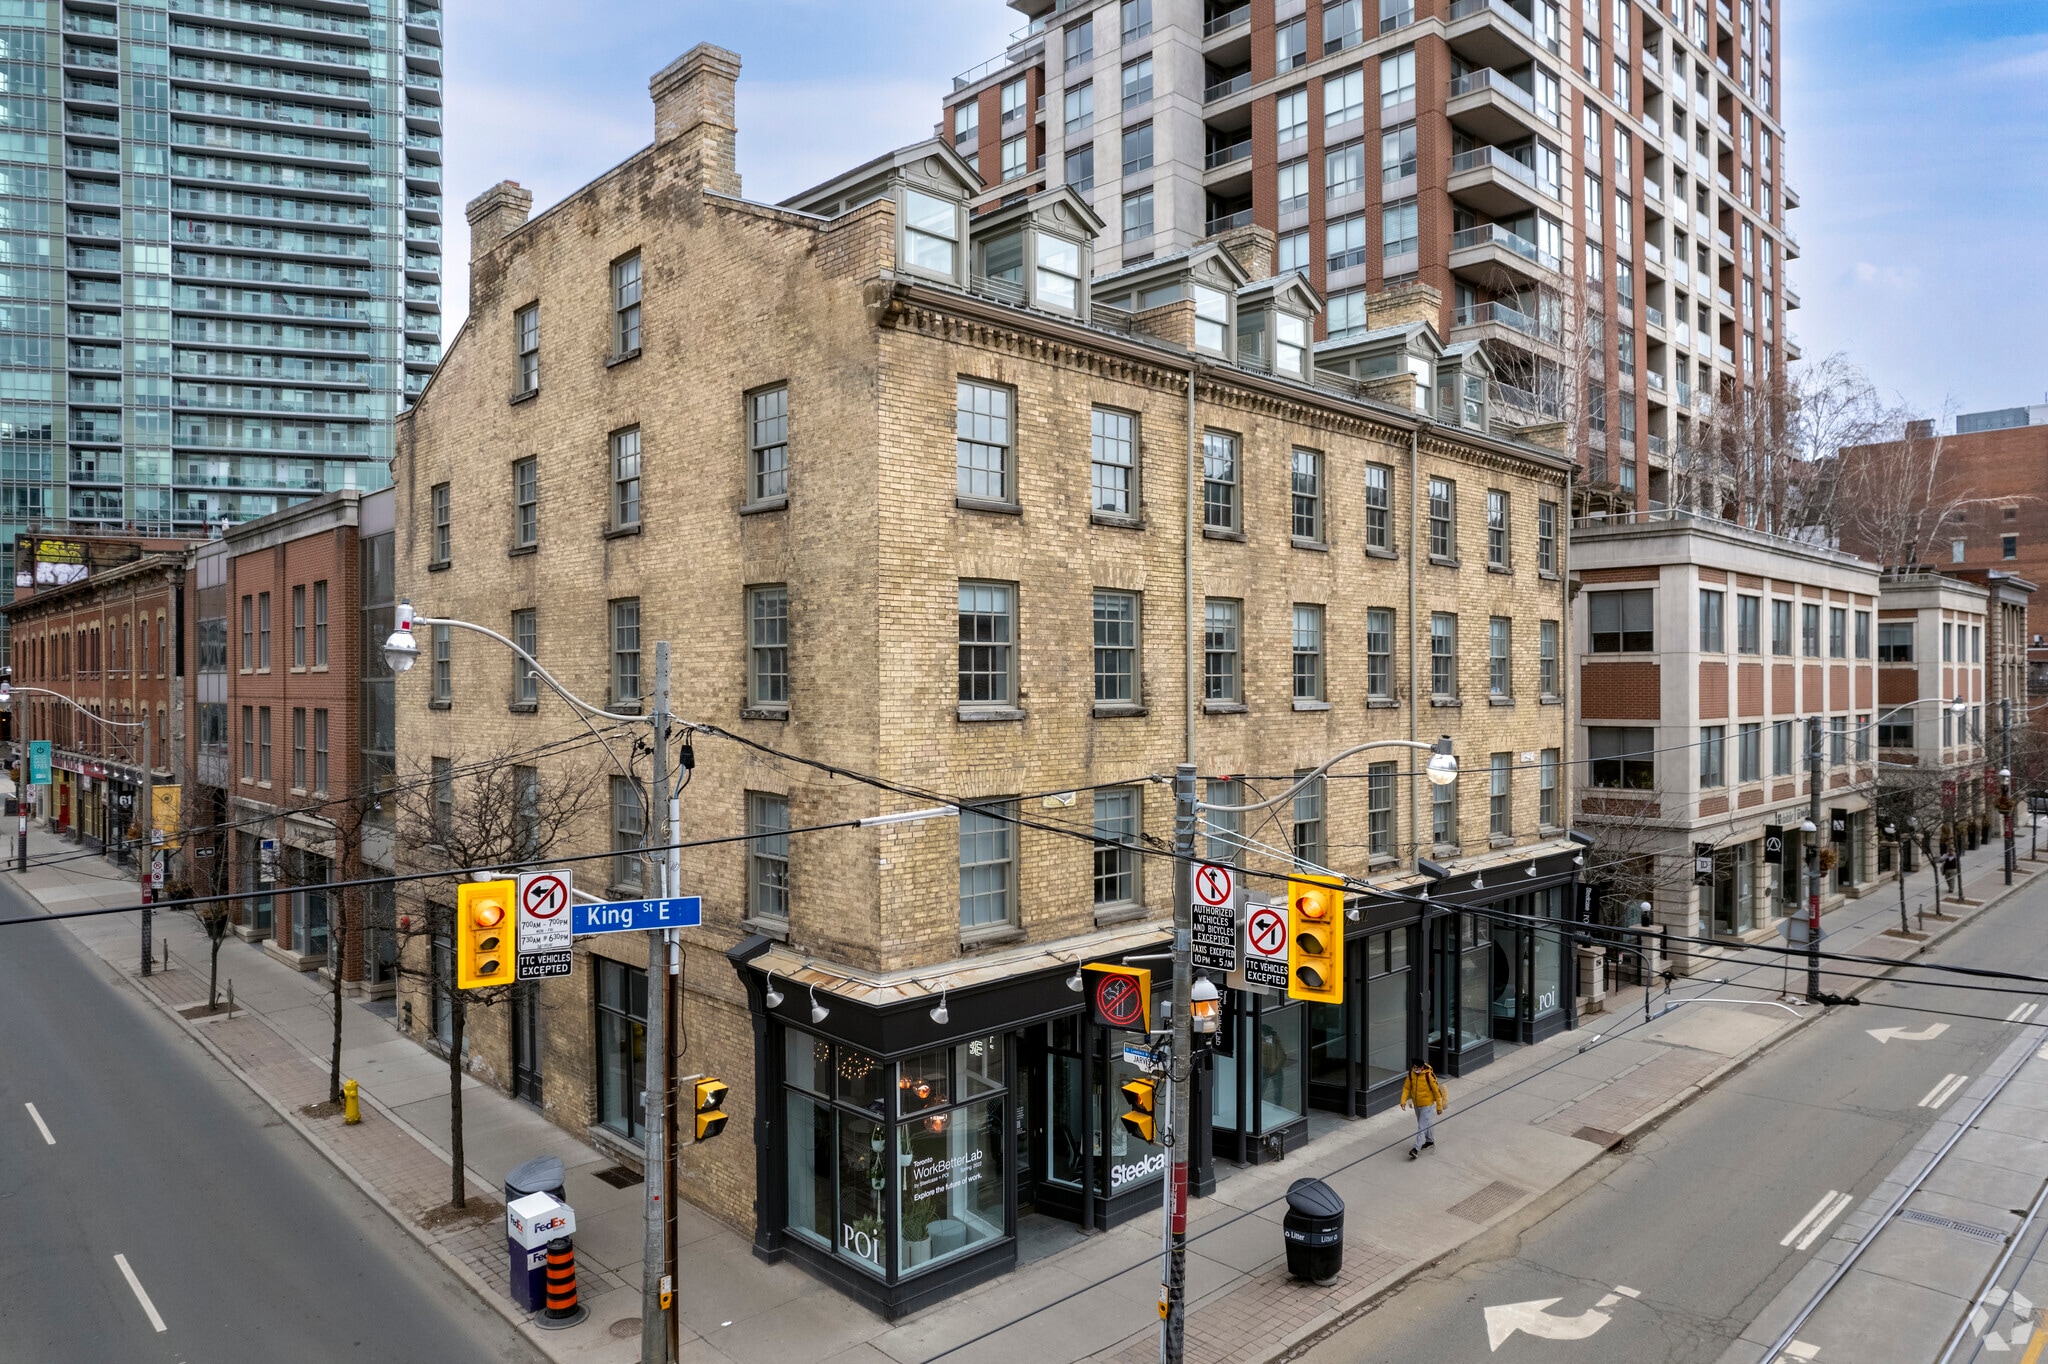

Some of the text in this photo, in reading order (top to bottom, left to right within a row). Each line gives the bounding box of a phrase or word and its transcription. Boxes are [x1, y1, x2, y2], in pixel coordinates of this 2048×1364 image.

[119, 795, 132, 805] 61
[587, 901, 670, 928] King St E
[1193, 905, 1234, 918] AUTHORIZED
[1198, 914, 1229, 926] VEHICLES
[1193, 923, 1234, 937] AND BICYCLES
[1197, 932, 1230, 945] EXCEPTED
[1192, 944, 1235, 959] TAXIS EXCEPTED
[520, 953, 571, 966] TTC VEHICLES
[1194, 954, 1211, 965] 10PM
[522, 964, 569, 976] EXCEPTED
[1246, 960, 1289, 975] TTC VEHICLES
[1247, 971, 1287, 985] EXCEPTED
[913, 1157, 933, 1168] Toronto
[913, 1148, 983, 1181] WorkBetterLab
[913, 1189, 935, 1202] Explore
[935, 1185, 945, 1194] the
[945, 1179, 961, 1190] future
[961, 1176, 968, 1185] of
[534, 1216, 567, 1234] FedEx
[1290, 1231, 1305, 1241] Litter
[1321, 1235, 1334, 1243] Litter
